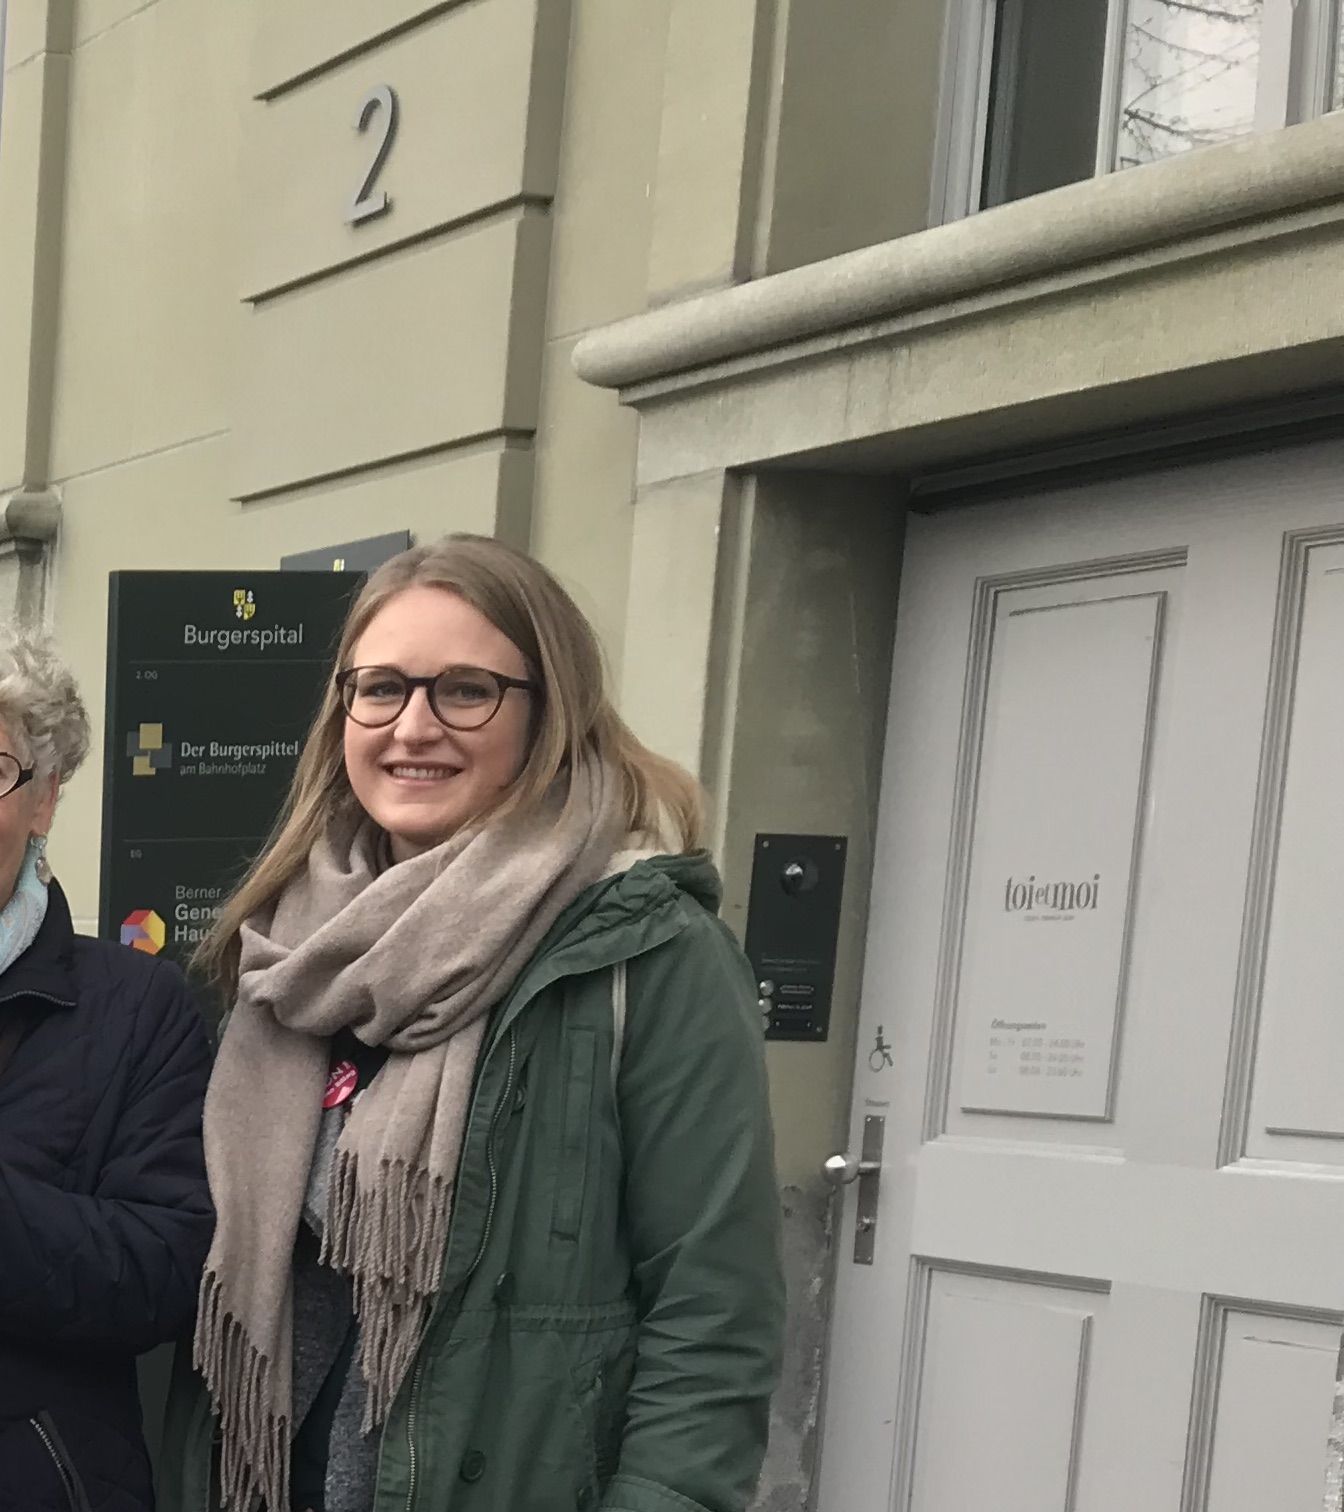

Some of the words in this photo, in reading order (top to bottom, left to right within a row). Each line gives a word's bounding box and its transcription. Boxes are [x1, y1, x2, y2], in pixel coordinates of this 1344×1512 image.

[345, 84, 399, 227] 2
[184, 624, 303, 650] Burgerspital
[180, 741, 205, 757] Der
[210, 741, 299, 760] Burgerspittel
[180, 764, 196, 775] am
[198, 762, 266, 777] Bahnhofplatz
[175, 885, 222, 900] Berner
